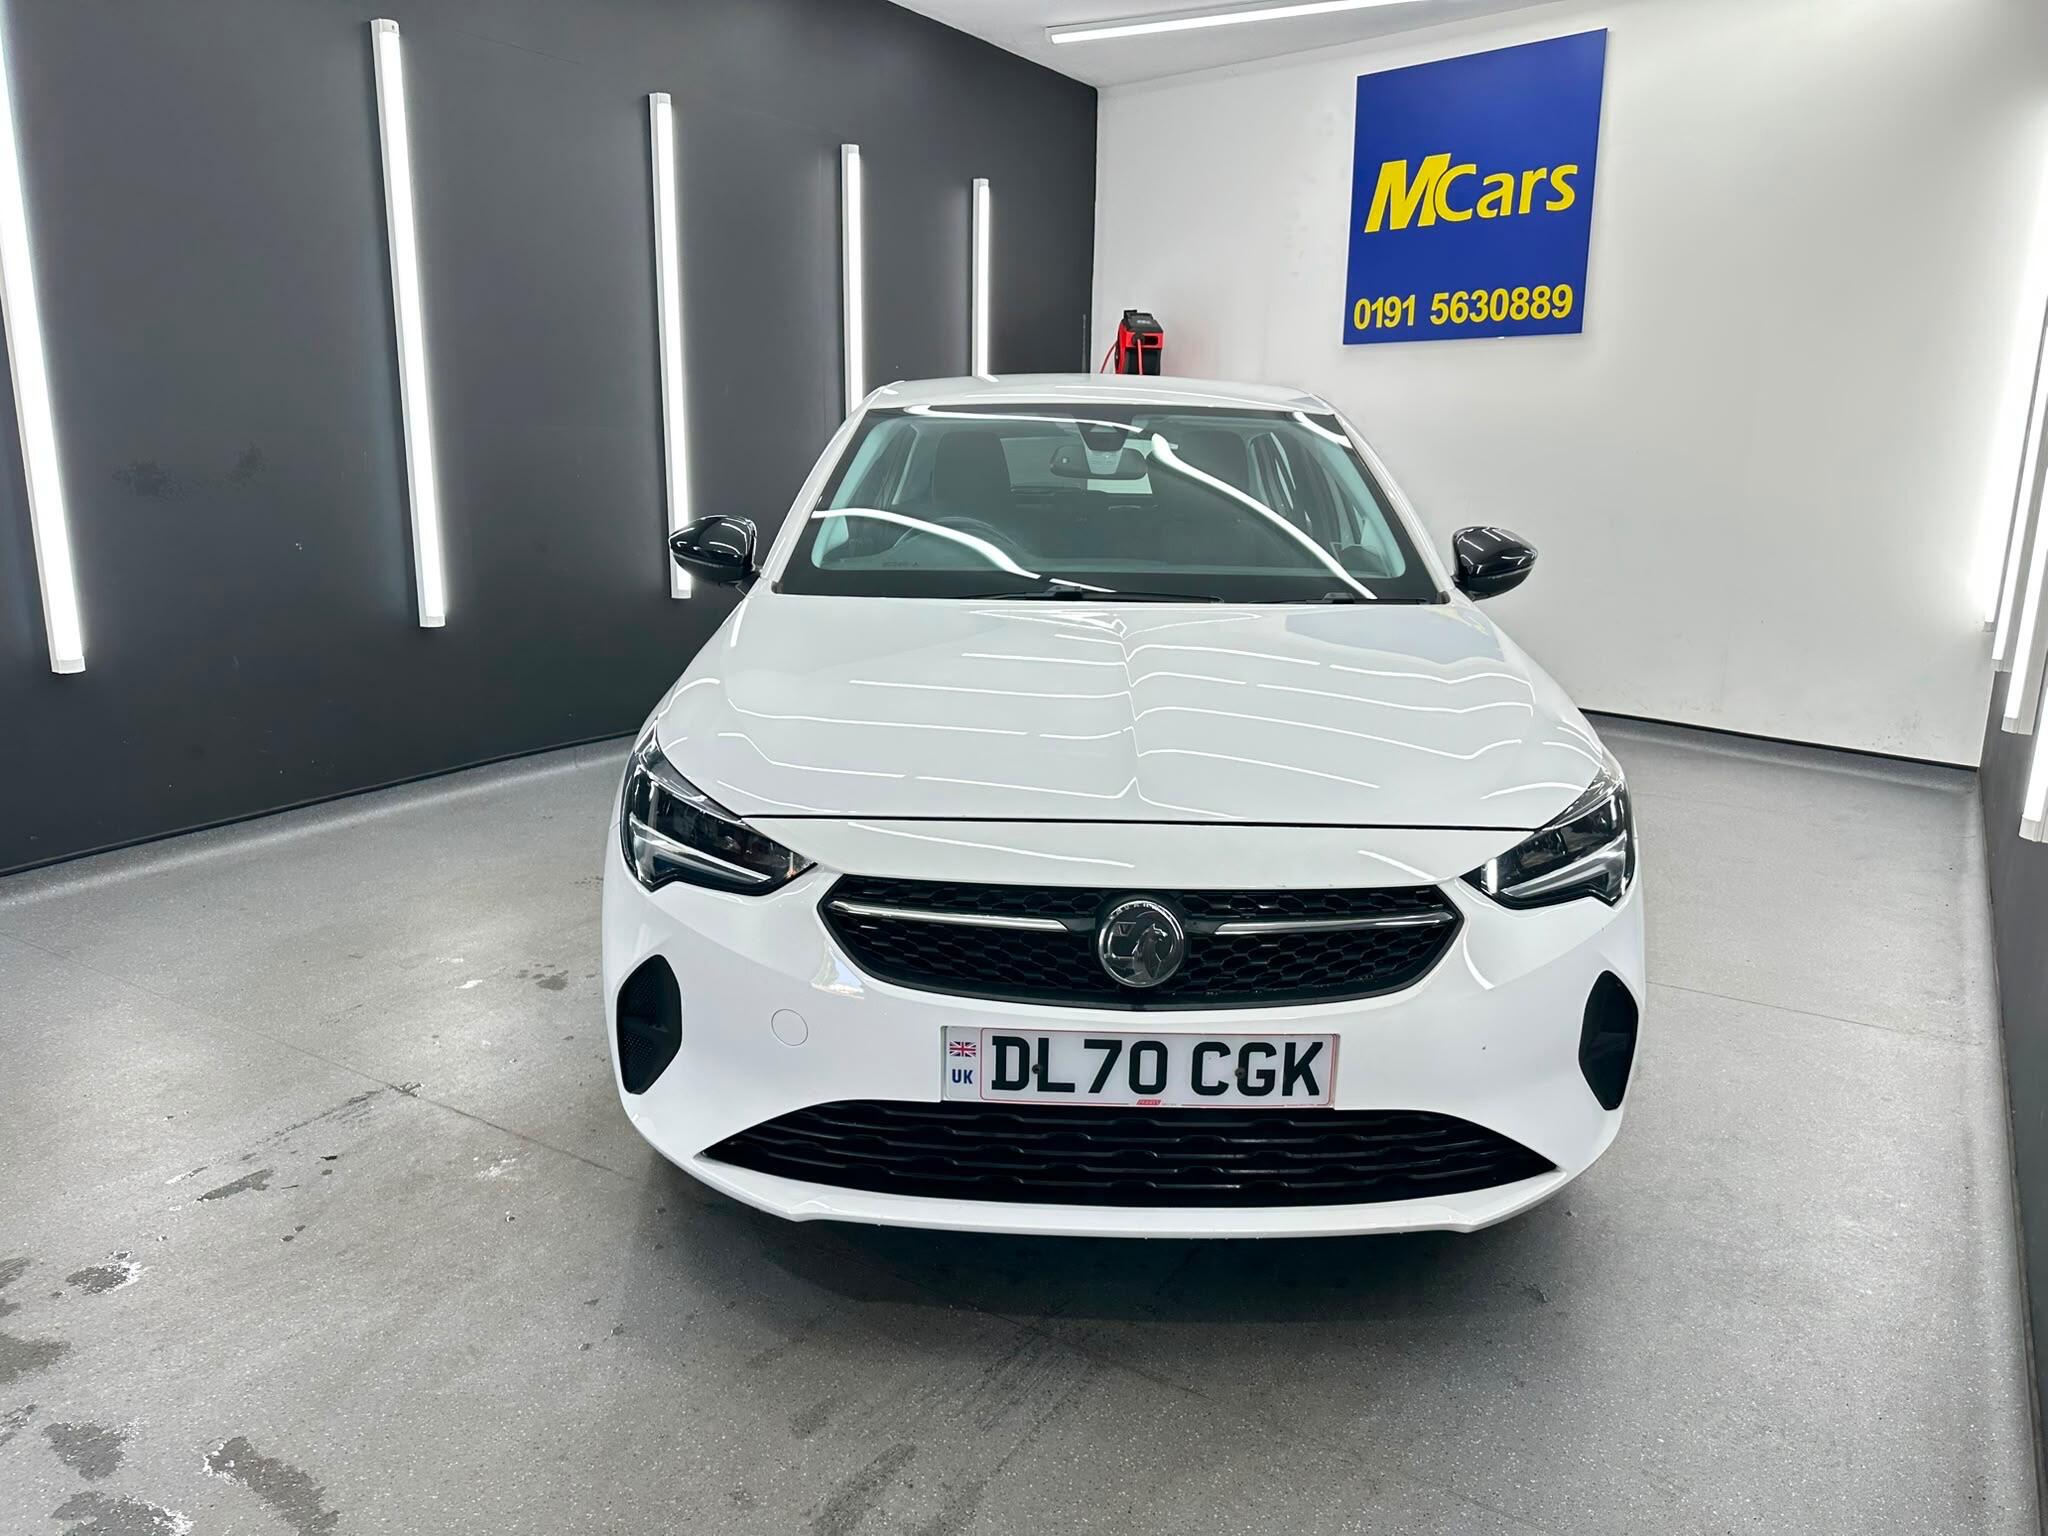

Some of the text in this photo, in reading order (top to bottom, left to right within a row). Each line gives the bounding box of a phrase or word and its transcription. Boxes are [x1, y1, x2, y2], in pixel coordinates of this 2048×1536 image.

[1364, 153, 1578, 233] MCars
[1353, 284, 1573, 330] 0191 5630889
[951, 1068, 973, 1085] UK
[991, 1035, 1323, 1097] DL70 CGK
